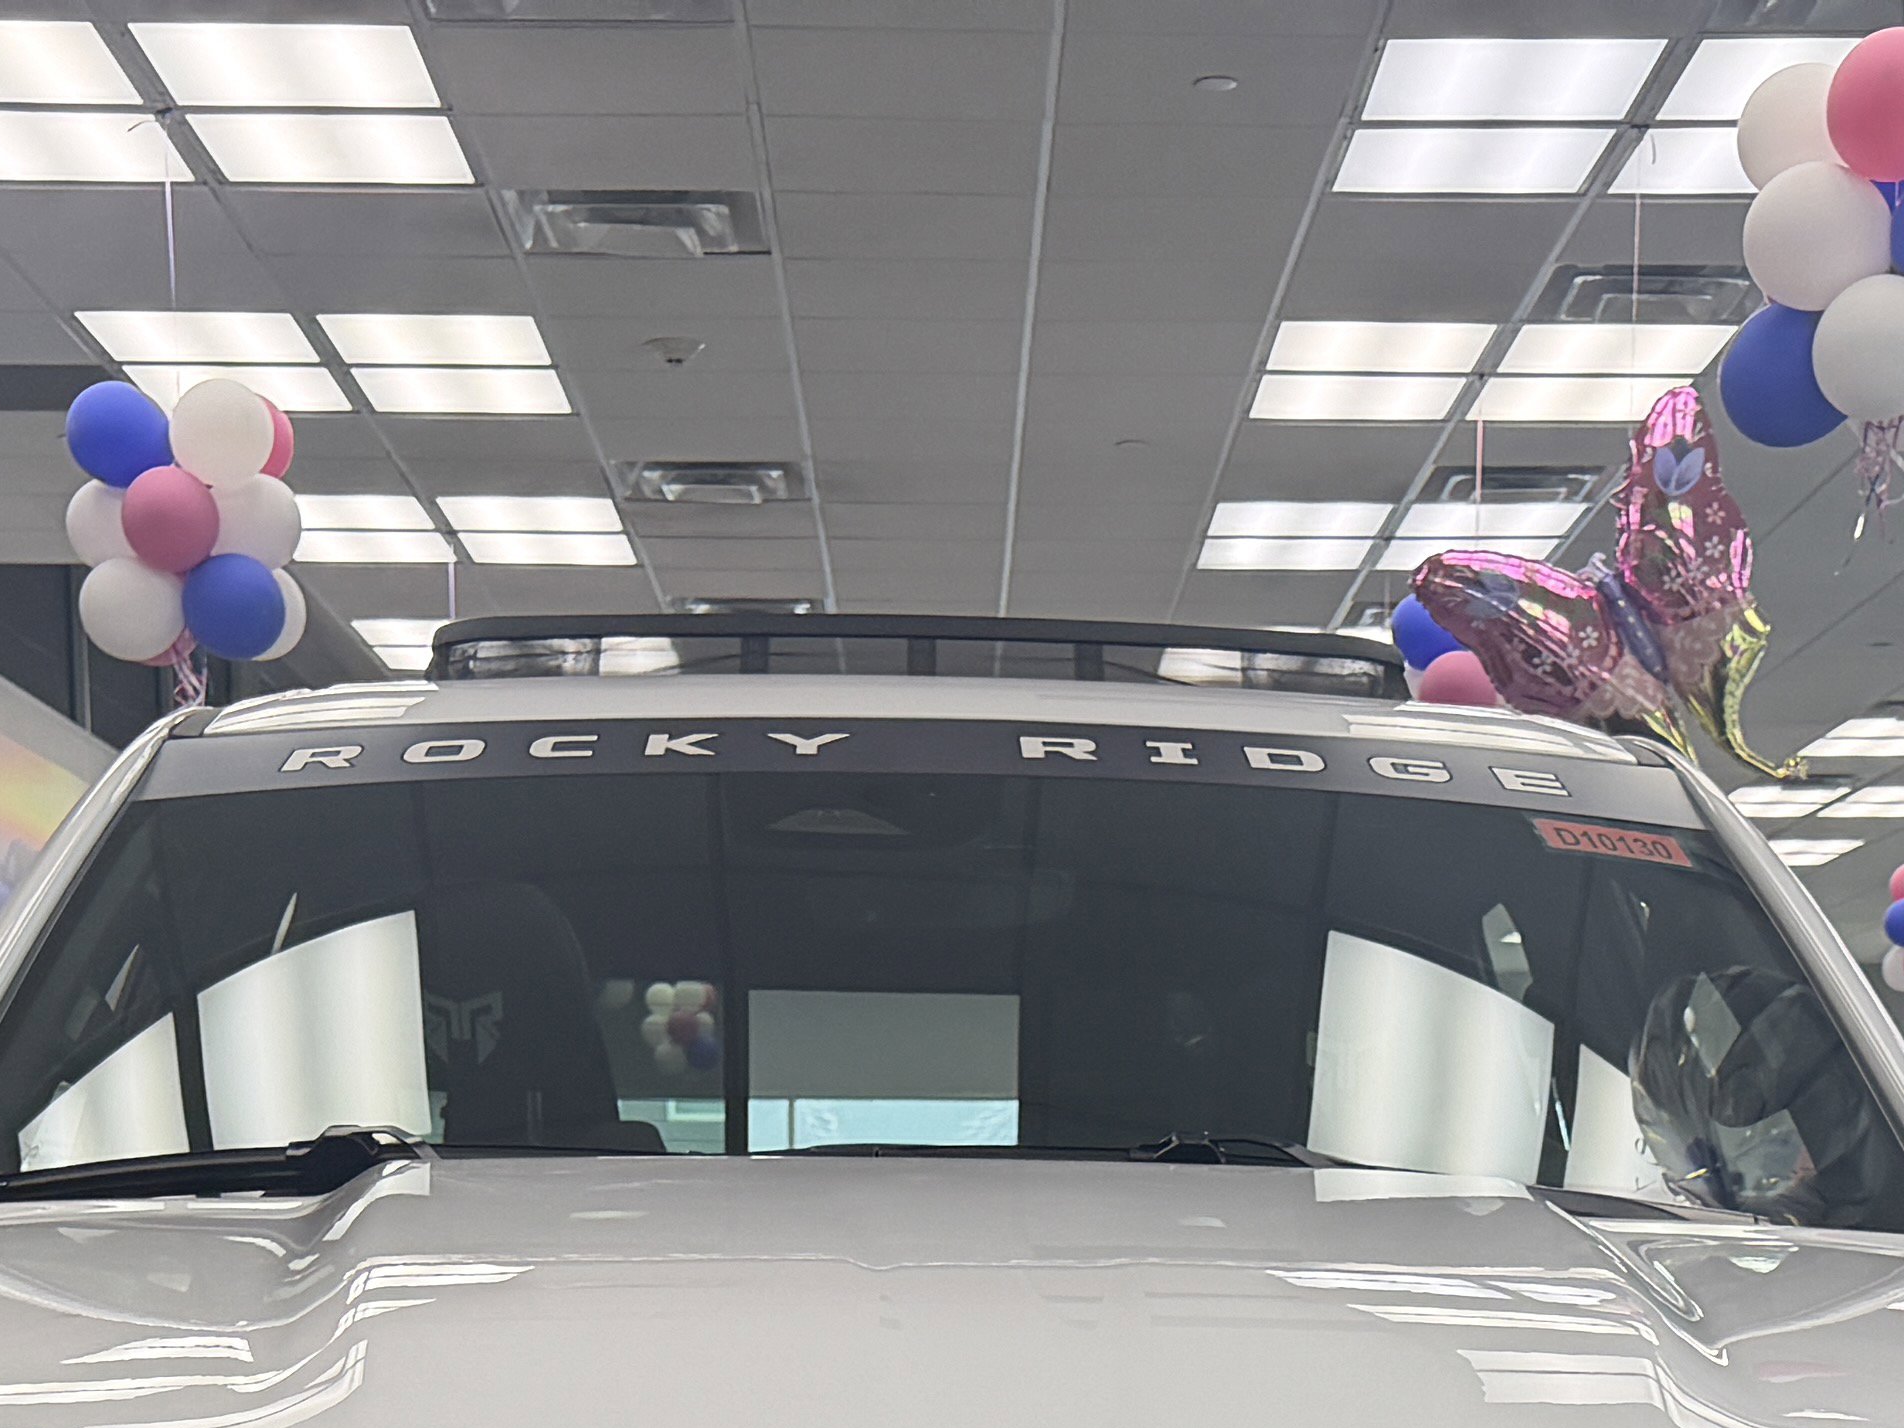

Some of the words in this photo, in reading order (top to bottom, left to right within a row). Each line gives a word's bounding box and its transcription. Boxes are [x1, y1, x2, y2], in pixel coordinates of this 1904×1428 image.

[279, 732, 851, 772] ROCKY
[1018, 735, 1572, 797] RIDGE
[1553, 826, 1673, 860] D10130
